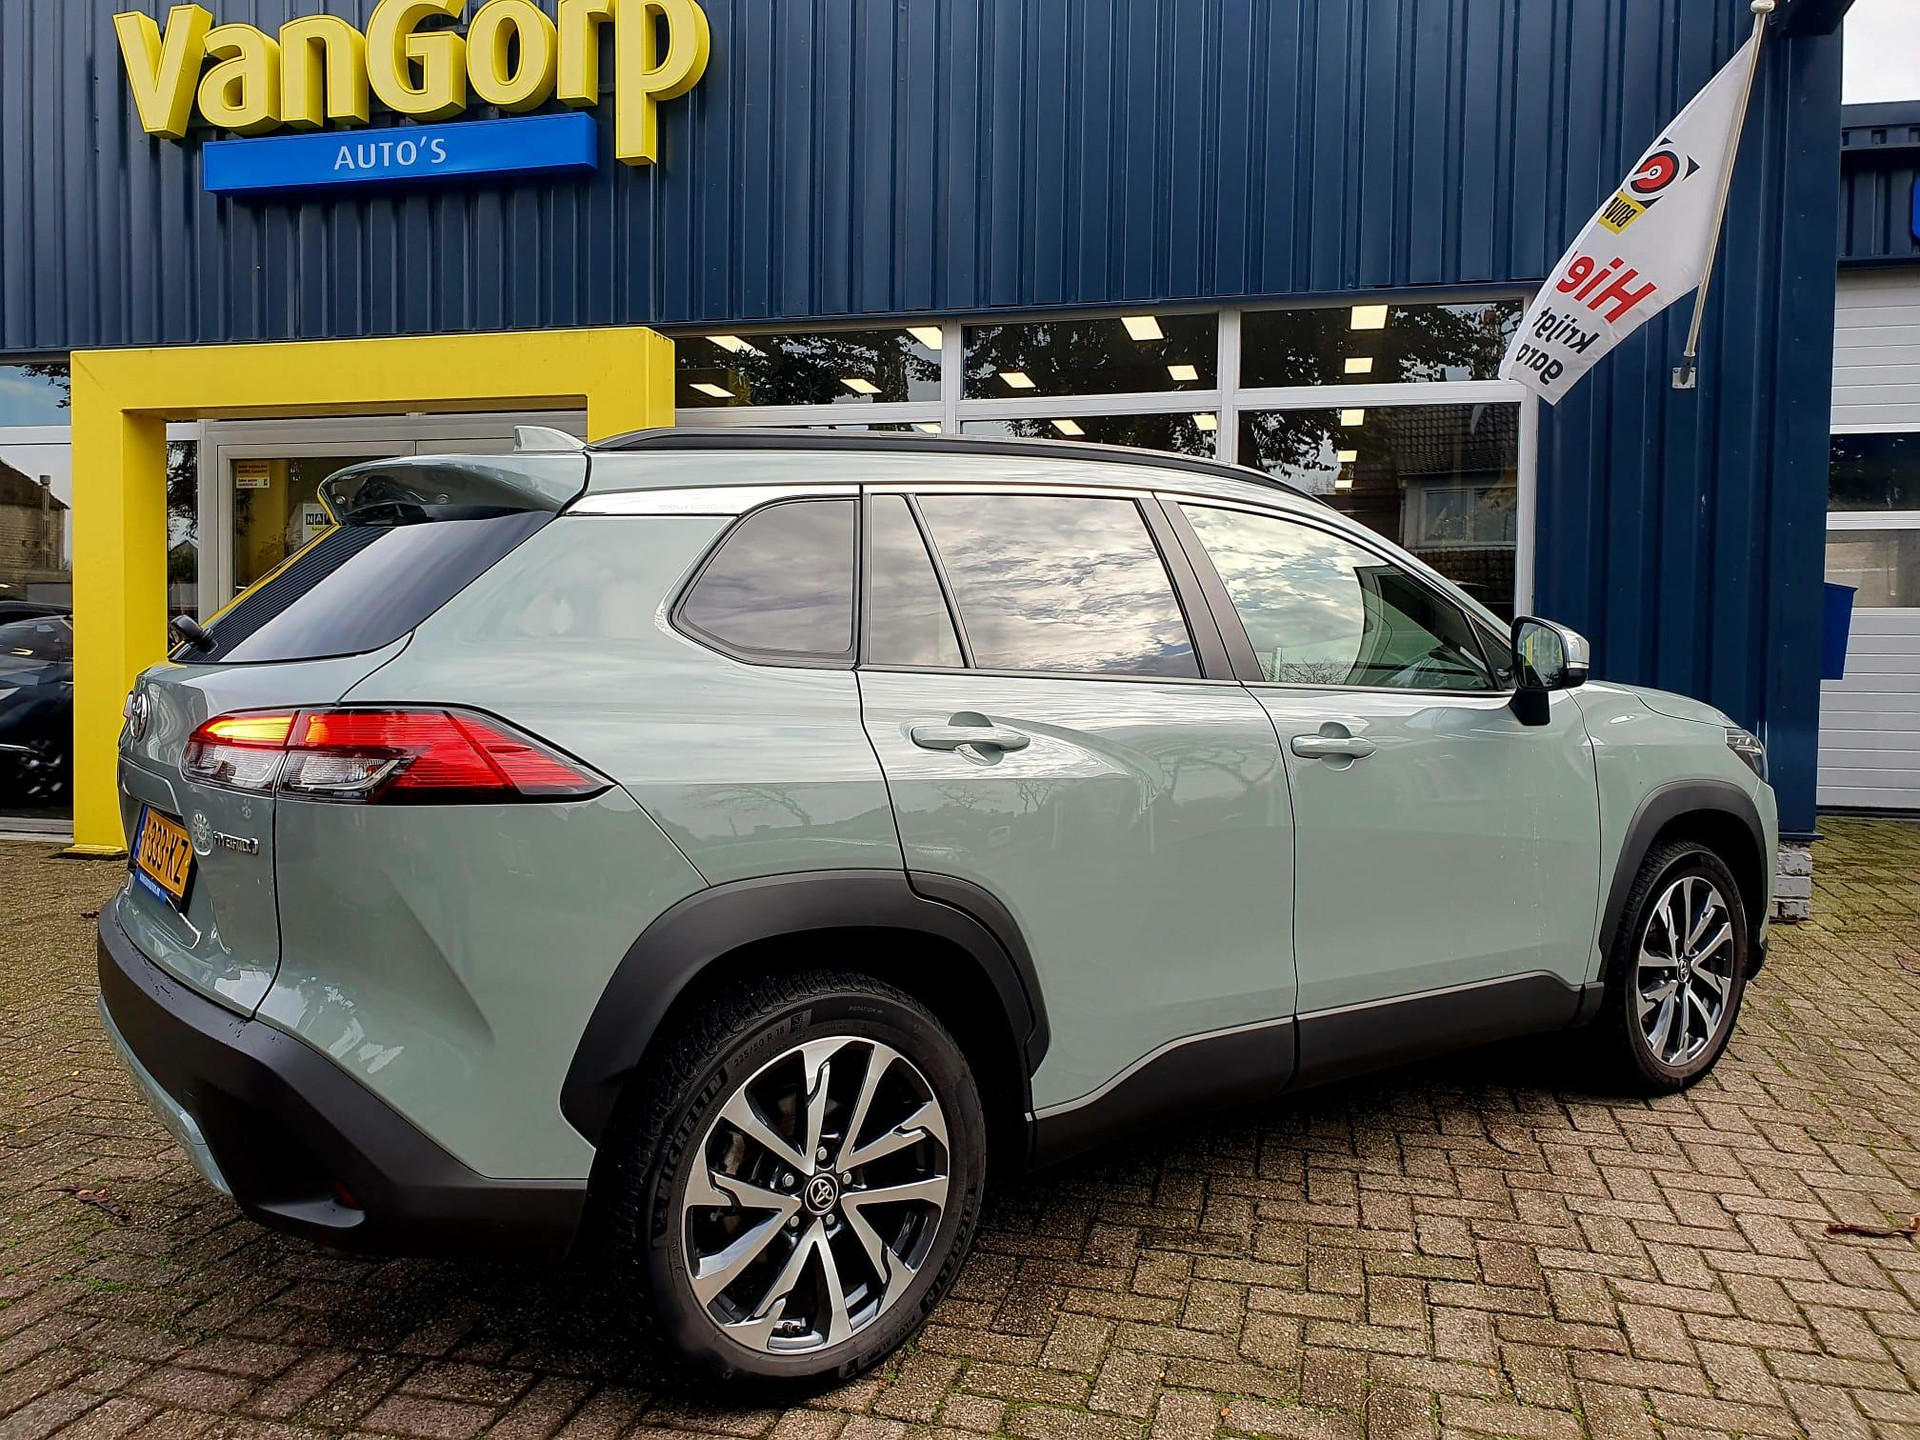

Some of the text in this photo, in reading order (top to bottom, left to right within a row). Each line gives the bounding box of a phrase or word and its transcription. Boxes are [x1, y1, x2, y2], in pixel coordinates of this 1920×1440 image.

[113, 0, 711, 165] VanGorp
[333, 137, 447, 171] AUTO'S
[656, 1072, 724, 1200] MICHELIN
